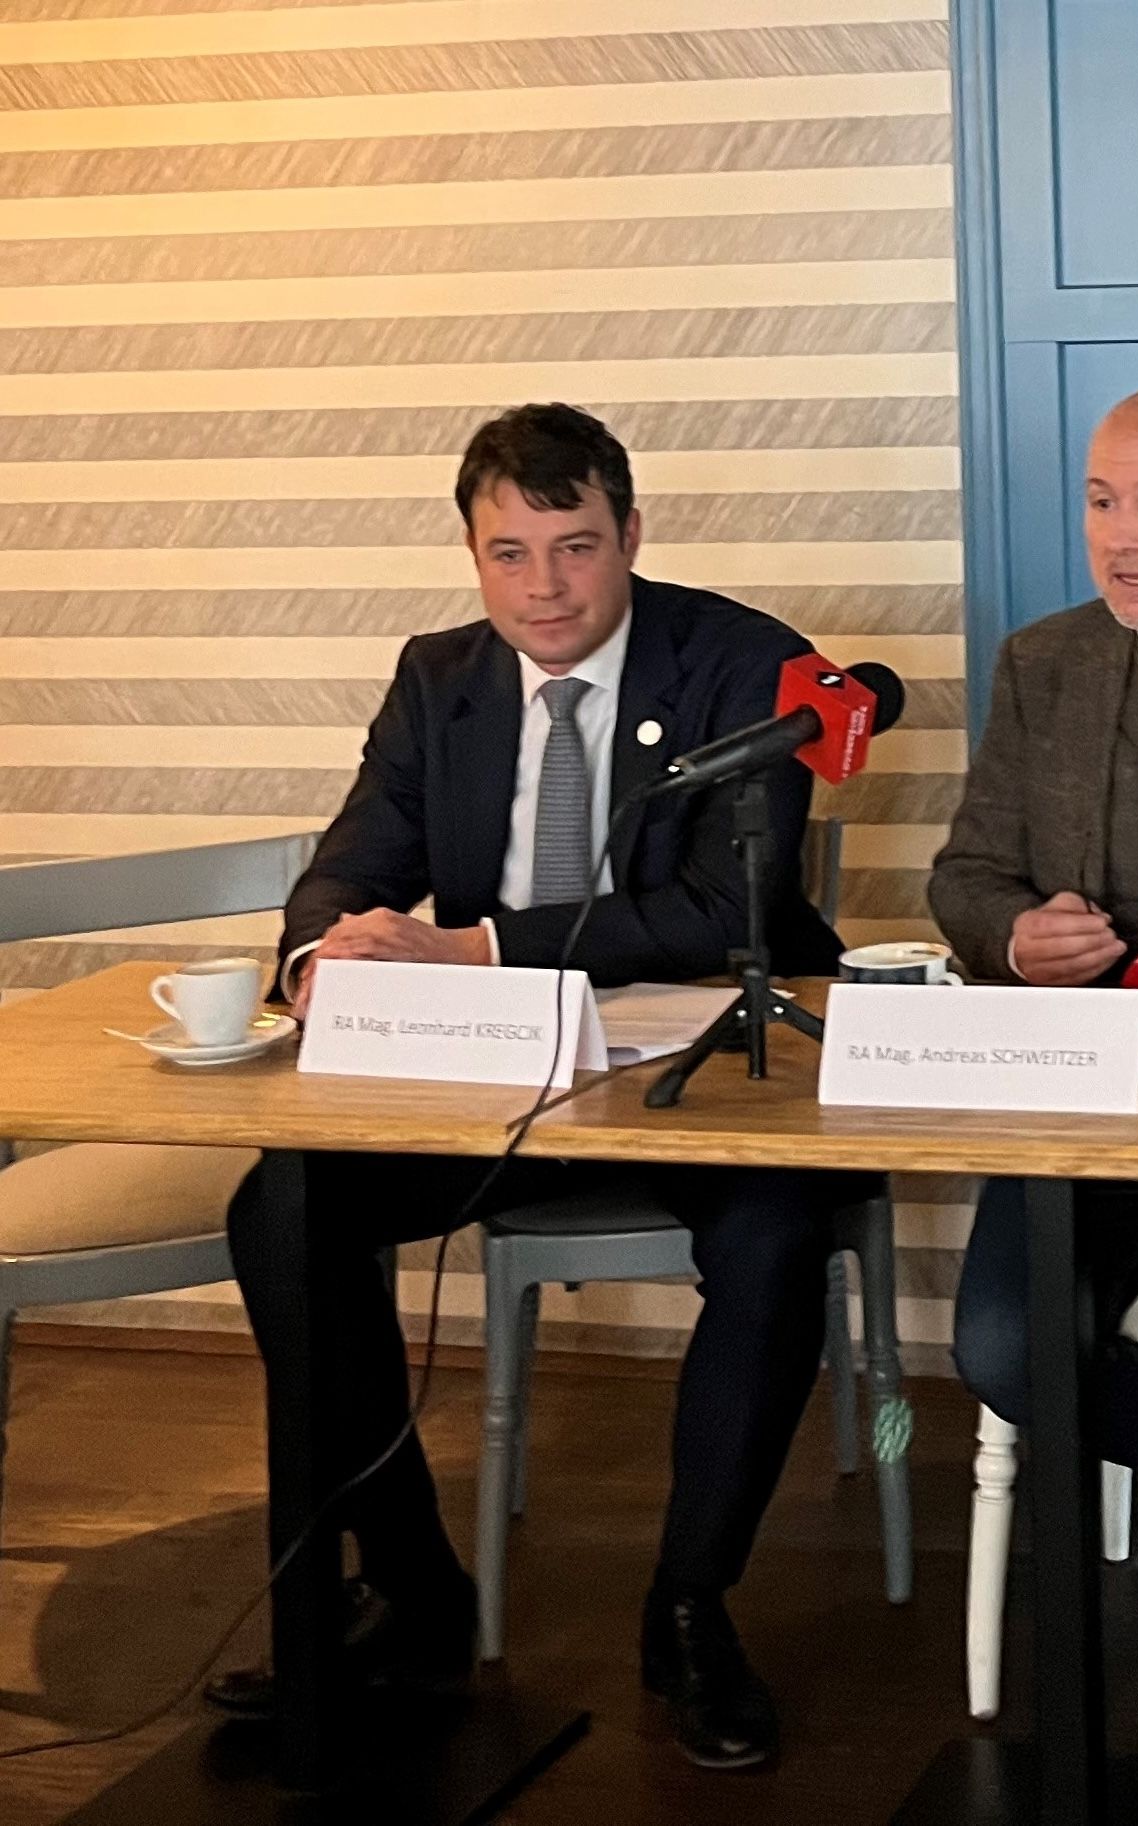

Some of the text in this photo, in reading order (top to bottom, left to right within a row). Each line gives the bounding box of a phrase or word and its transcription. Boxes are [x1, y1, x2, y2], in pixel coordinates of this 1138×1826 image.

[332, 1015, 354, 1031] RA
[848, 1046, 1098, 1066] RA Mag. Andreas SCHWEITZER
